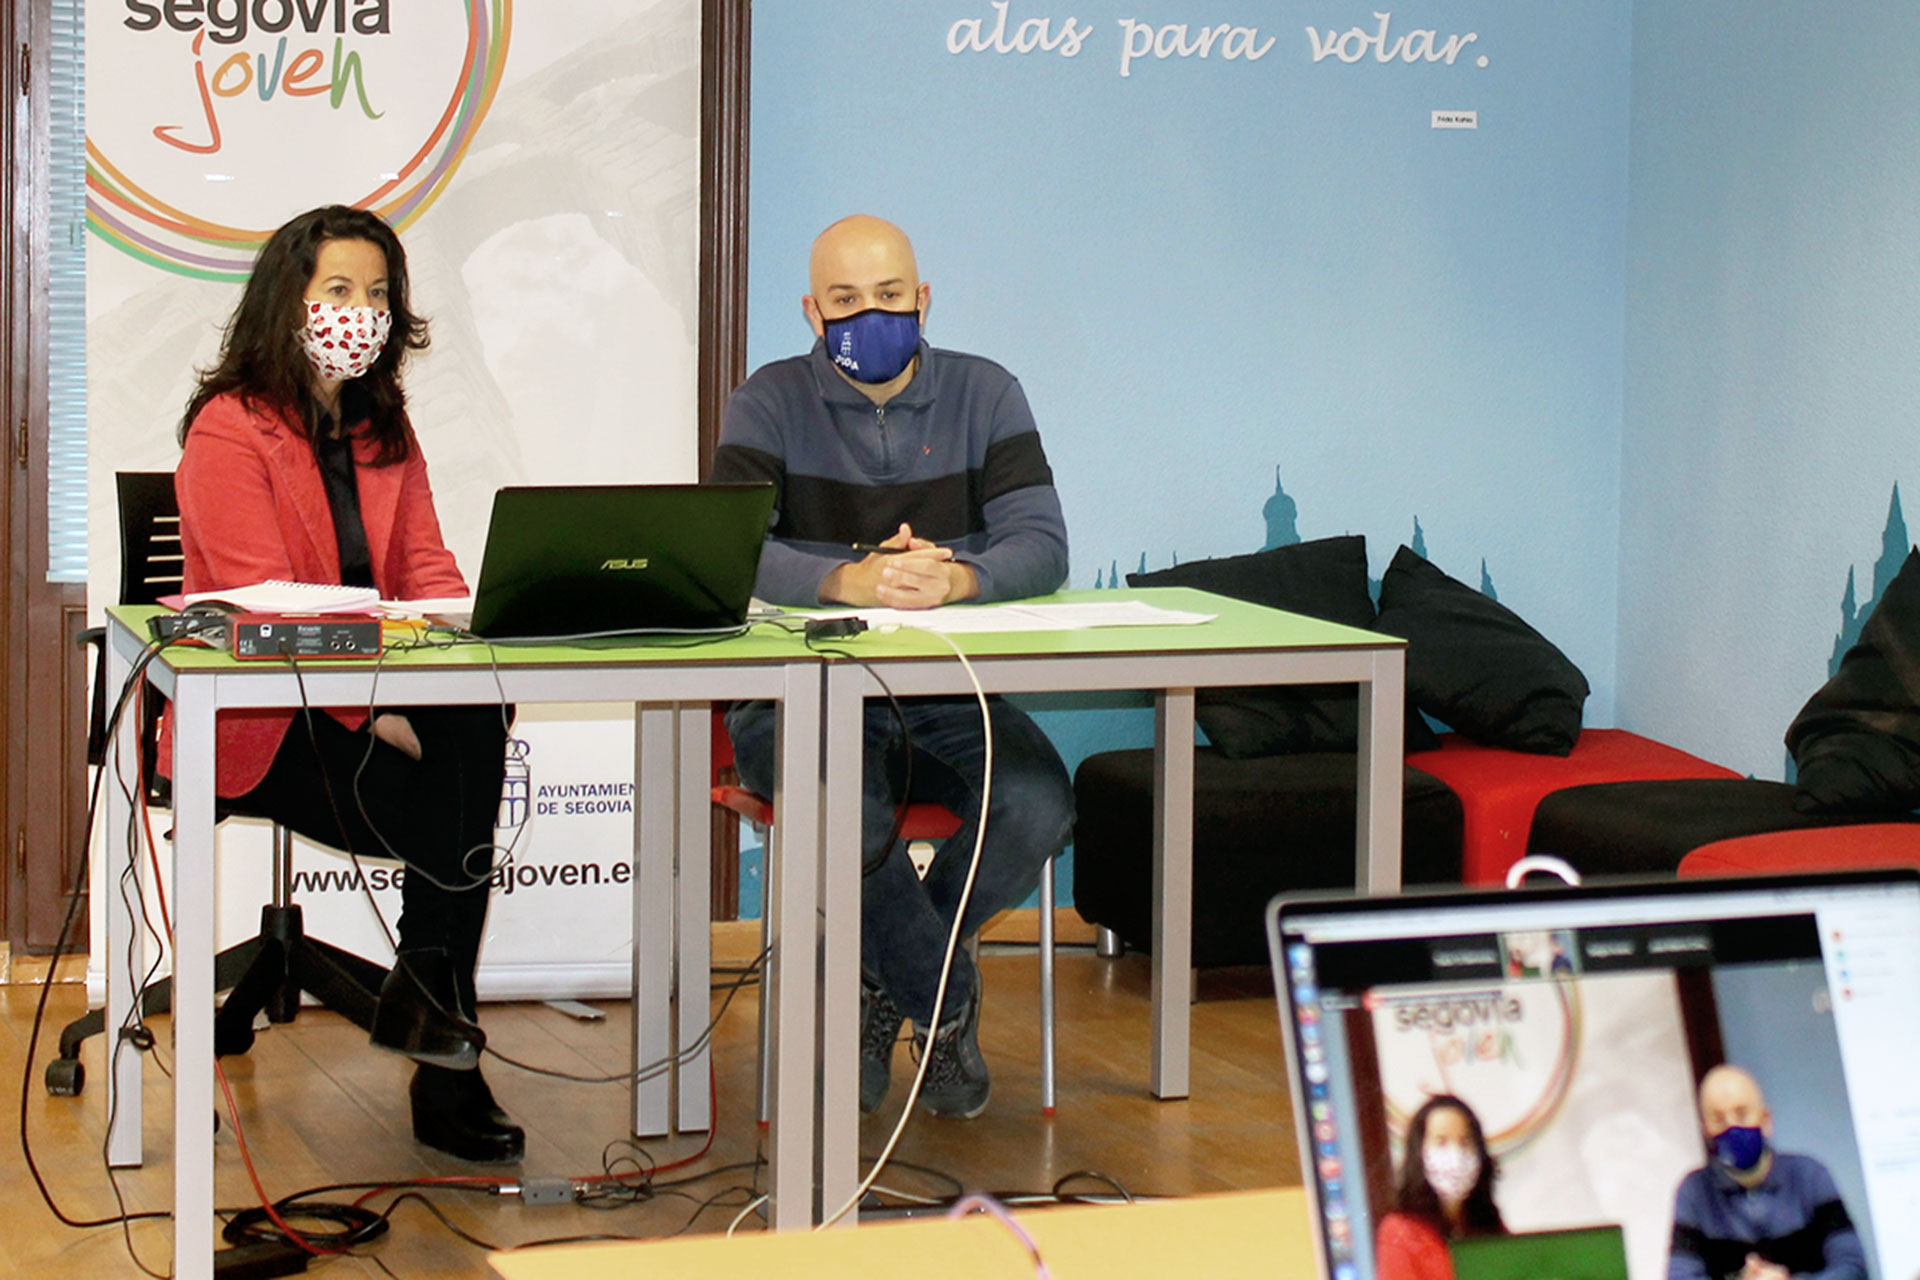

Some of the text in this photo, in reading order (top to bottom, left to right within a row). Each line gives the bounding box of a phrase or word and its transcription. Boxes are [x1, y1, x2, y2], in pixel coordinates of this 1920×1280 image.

[123, 0, 391, 45] segovia
[946, 0, 1490, 77] alas para volar.
[153, 29, 386, 154] joven
[600, 559, 649, 571] ASUS
[537, 783, 636, 798] AYUNTAMIEN
[537, 800, 633, 815] DE SEGOVIA
[1396, 996, 1523, 1034] segovia
